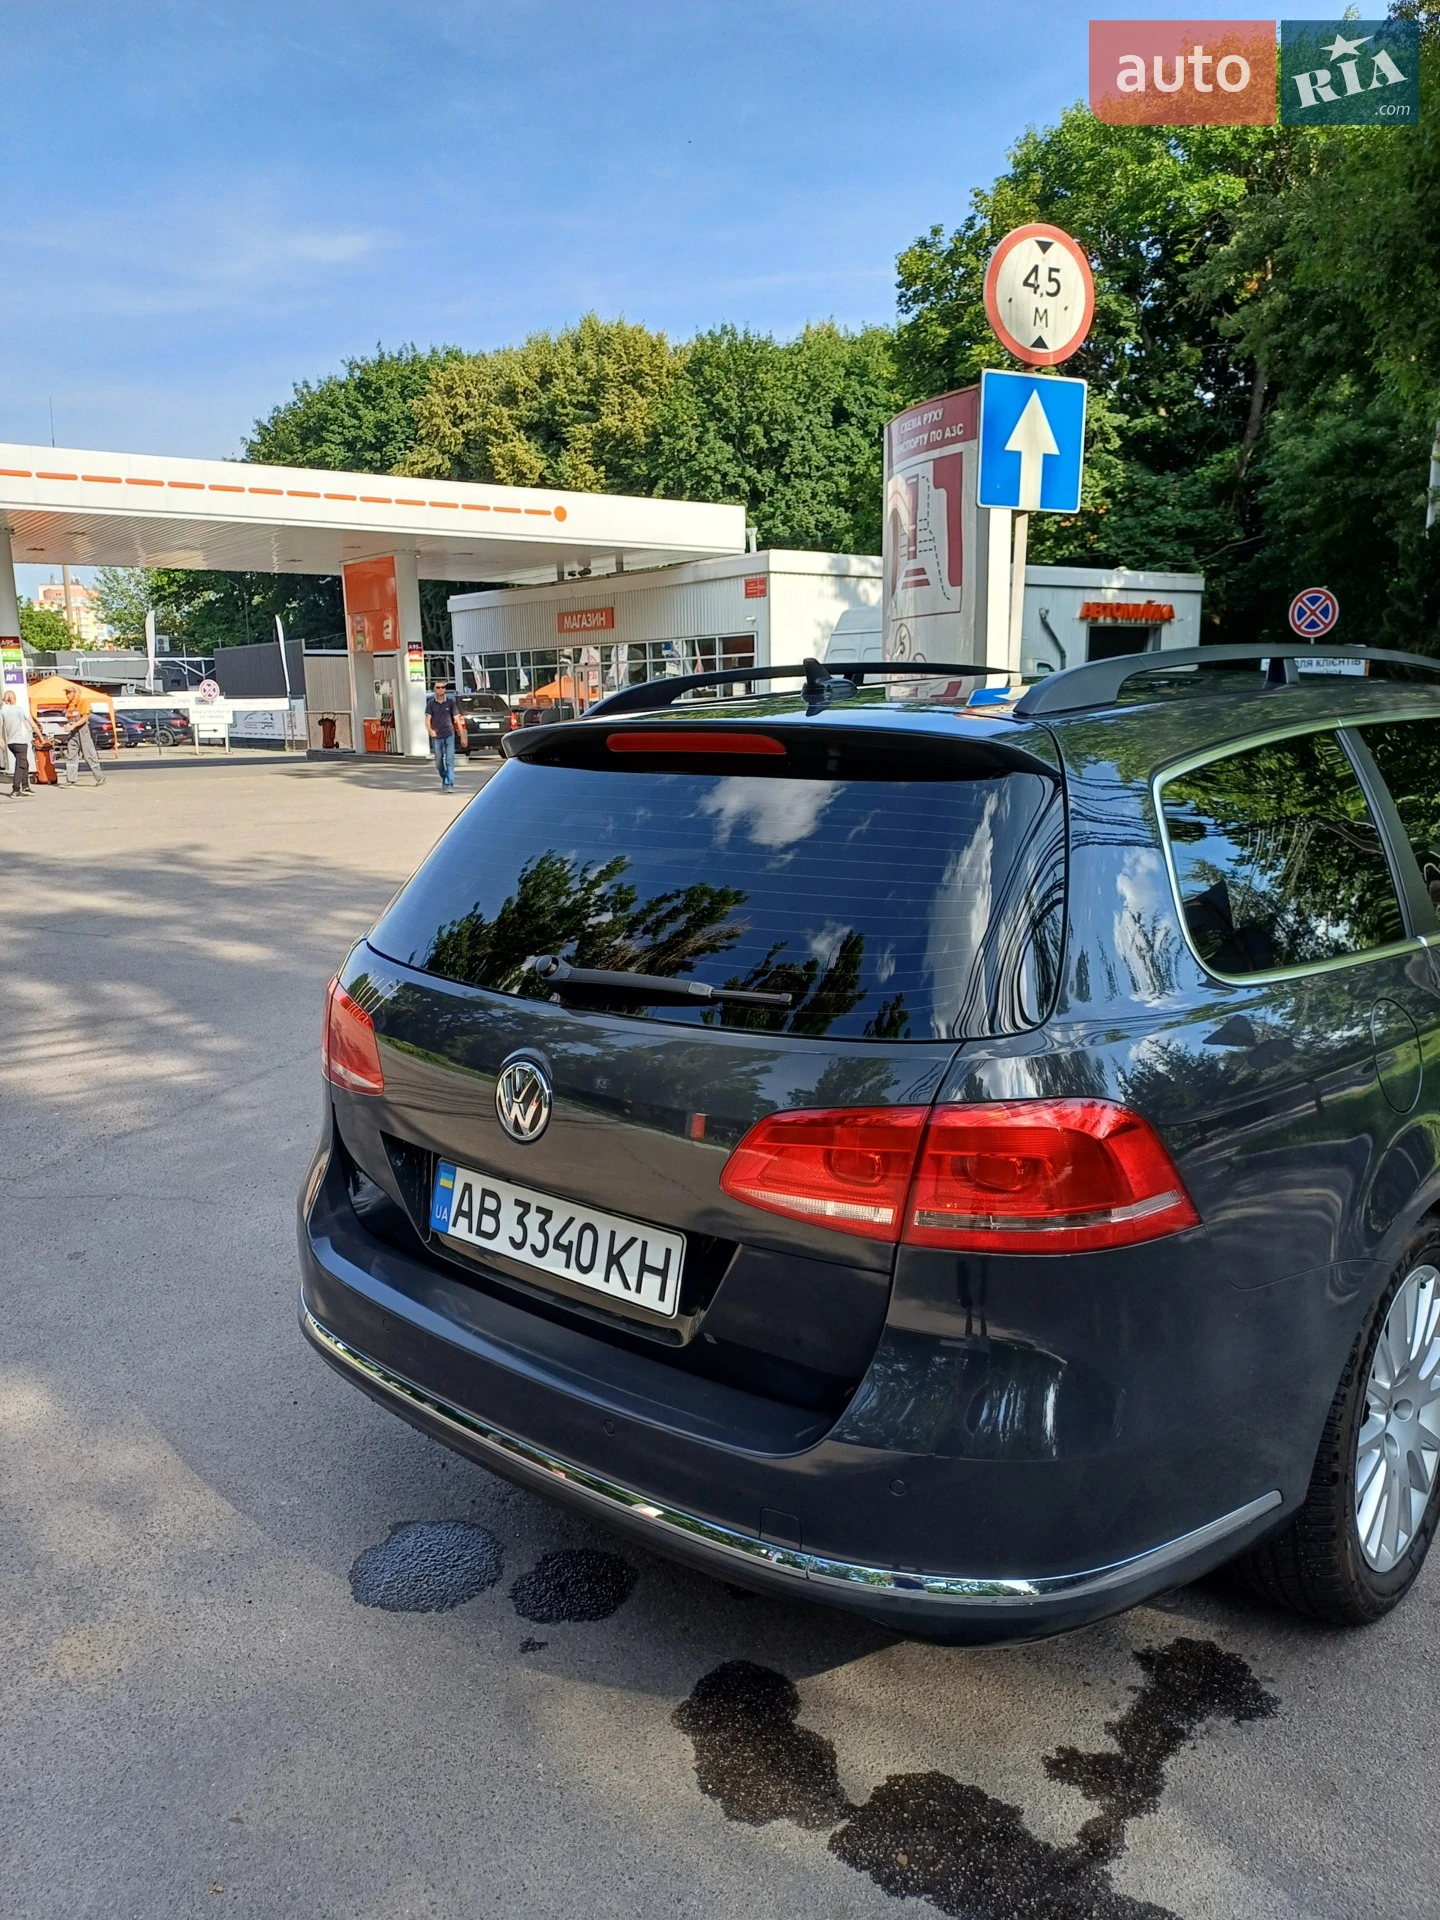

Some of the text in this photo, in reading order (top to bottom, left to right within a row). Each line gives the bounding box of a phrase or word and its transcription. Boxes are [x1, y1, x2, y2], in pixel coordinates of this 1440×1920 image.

[900, 407, 943, 434] СХЕМА РУХУ
[929, 428, 943, 443] ПО
[945, 422, 964, 439] АЗС
[563, 611, 606, 630] МАГАЗИН
[434, 1205, 449, 1223] UA
